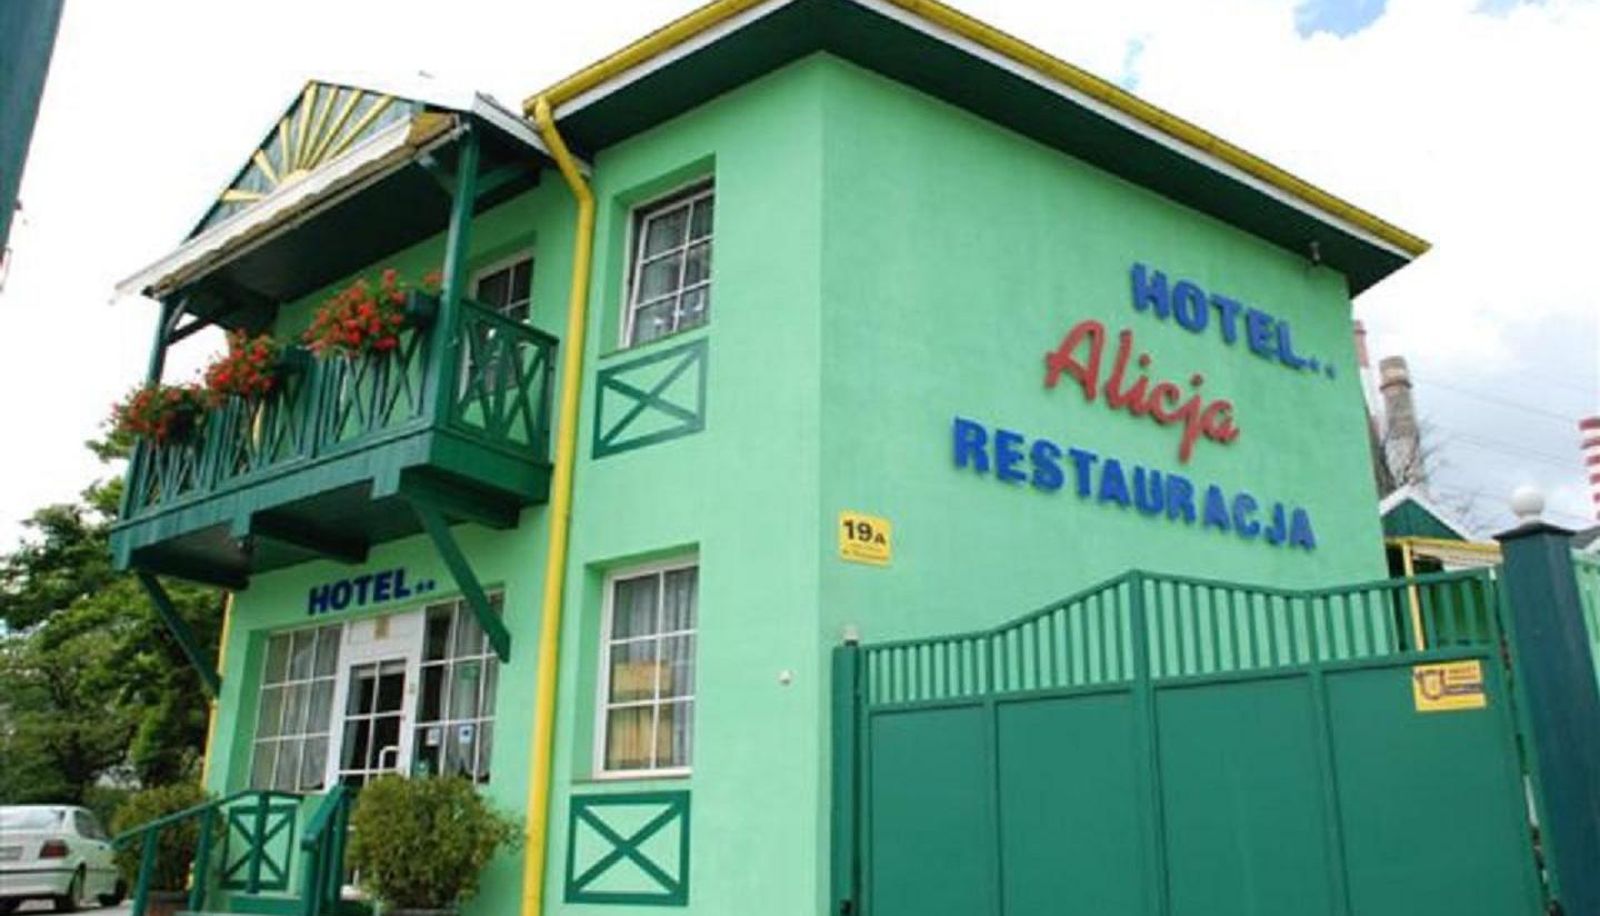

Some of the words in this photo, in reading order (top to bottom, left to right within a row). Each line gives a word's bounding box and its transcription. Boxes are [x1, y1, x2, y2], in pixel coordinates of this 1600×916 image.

[1044, 319, 1239, 464] Alicja
[843, 519, 887, 545] 19A
[952, 416, 1316, 552] RESTAURACJA
